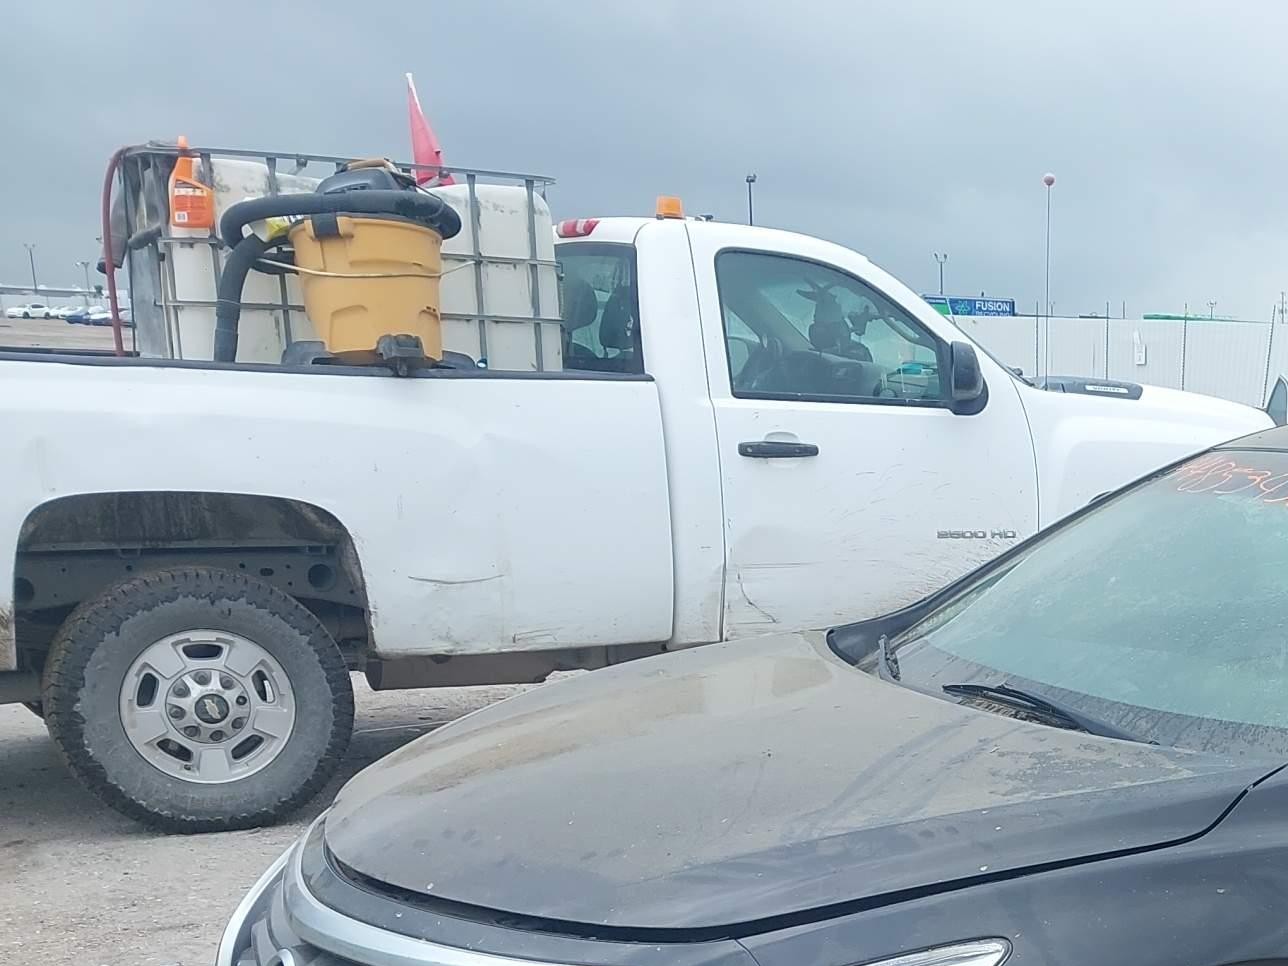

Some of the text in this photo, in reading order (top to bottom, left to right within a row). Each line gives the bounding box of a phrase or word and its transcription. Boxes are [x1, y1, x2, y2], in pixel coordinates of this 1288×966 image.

[976, 301, 1010, 311] FUSION
[937, 530, 1017, 539] 2500 HD
